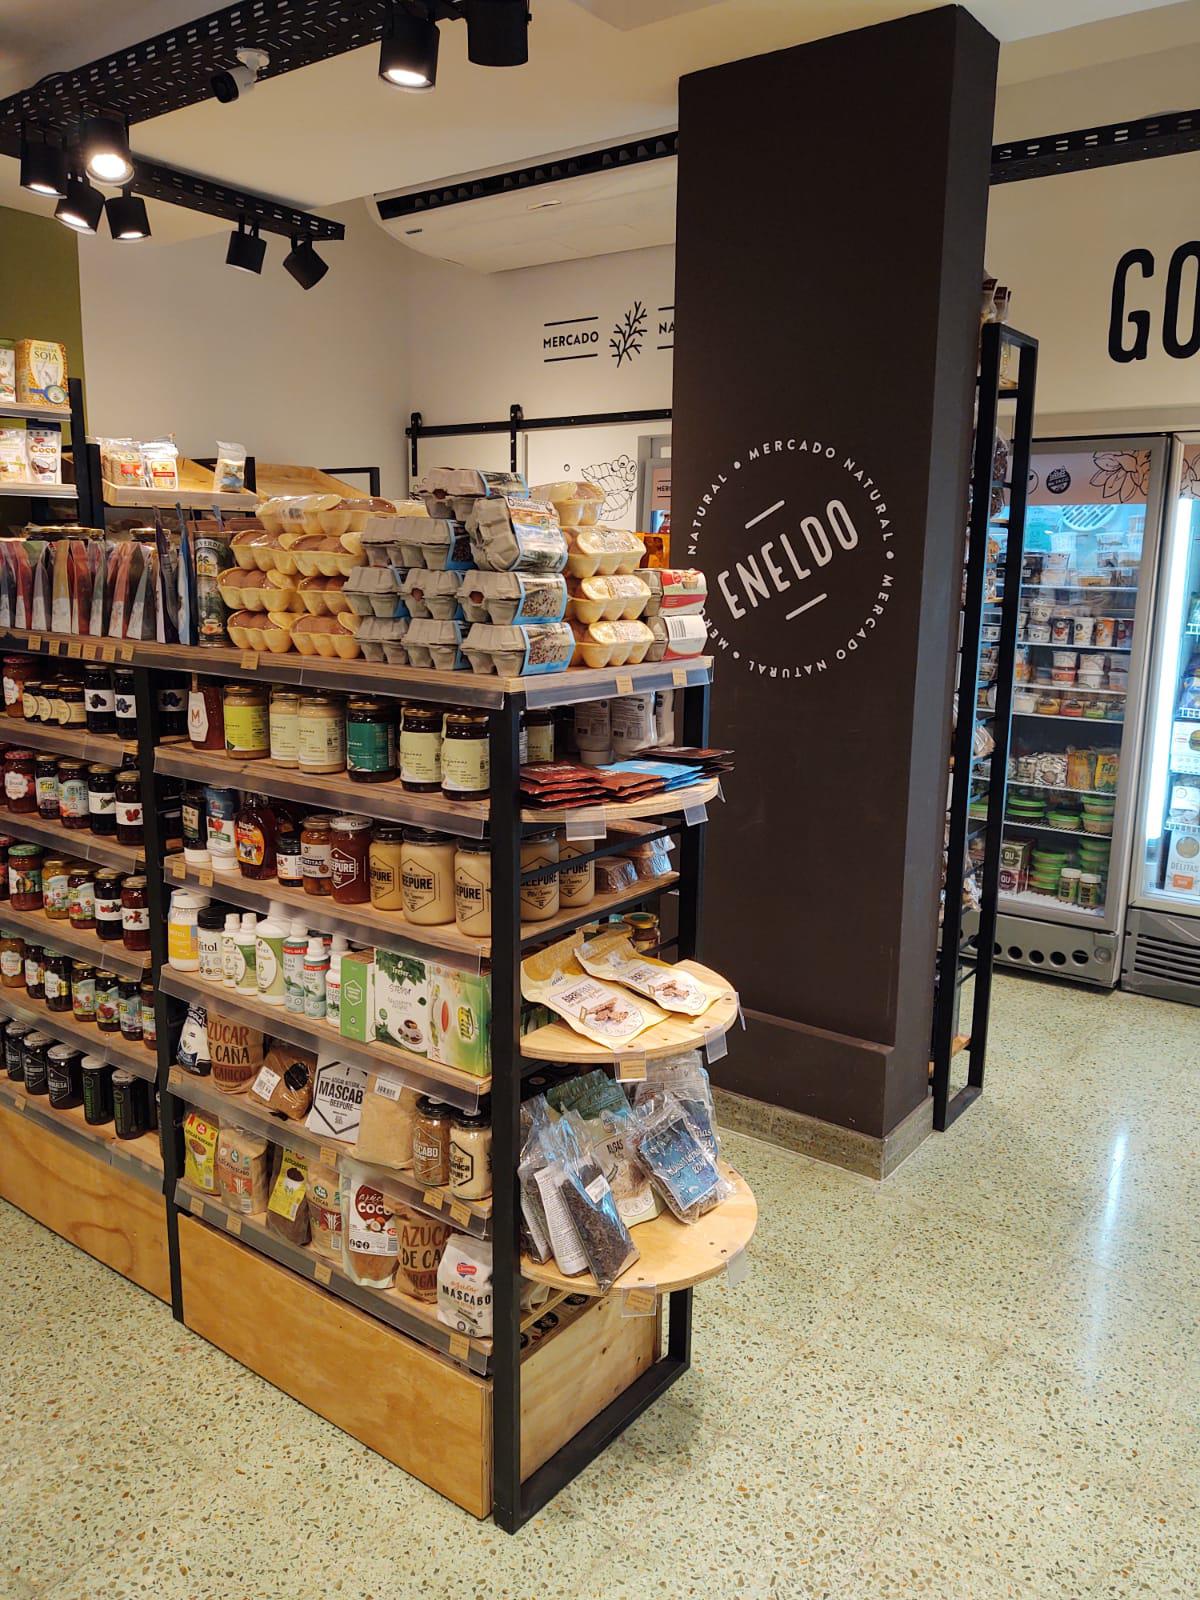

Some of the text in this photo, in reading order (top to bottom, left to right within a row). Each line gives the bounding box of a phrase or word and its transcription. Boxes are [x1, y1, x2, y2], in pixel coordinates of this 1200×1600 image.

[543, 330, 599, 349] MERCADO
[34, 350, 59, 361] SOJA
[749, 439, 894, 541] MERCADO NATURAL
[687, 473, 728, 555] NATURAL
[717, 499, 859, 620] ENELDO
[748, 574, 894, 678] MERCADO NATURAL
[215, 1044, 250, 1065] CAÑA
[402, 1249, 418, 1269] DE
[442, 1284, 492, 1306] MASCABO
